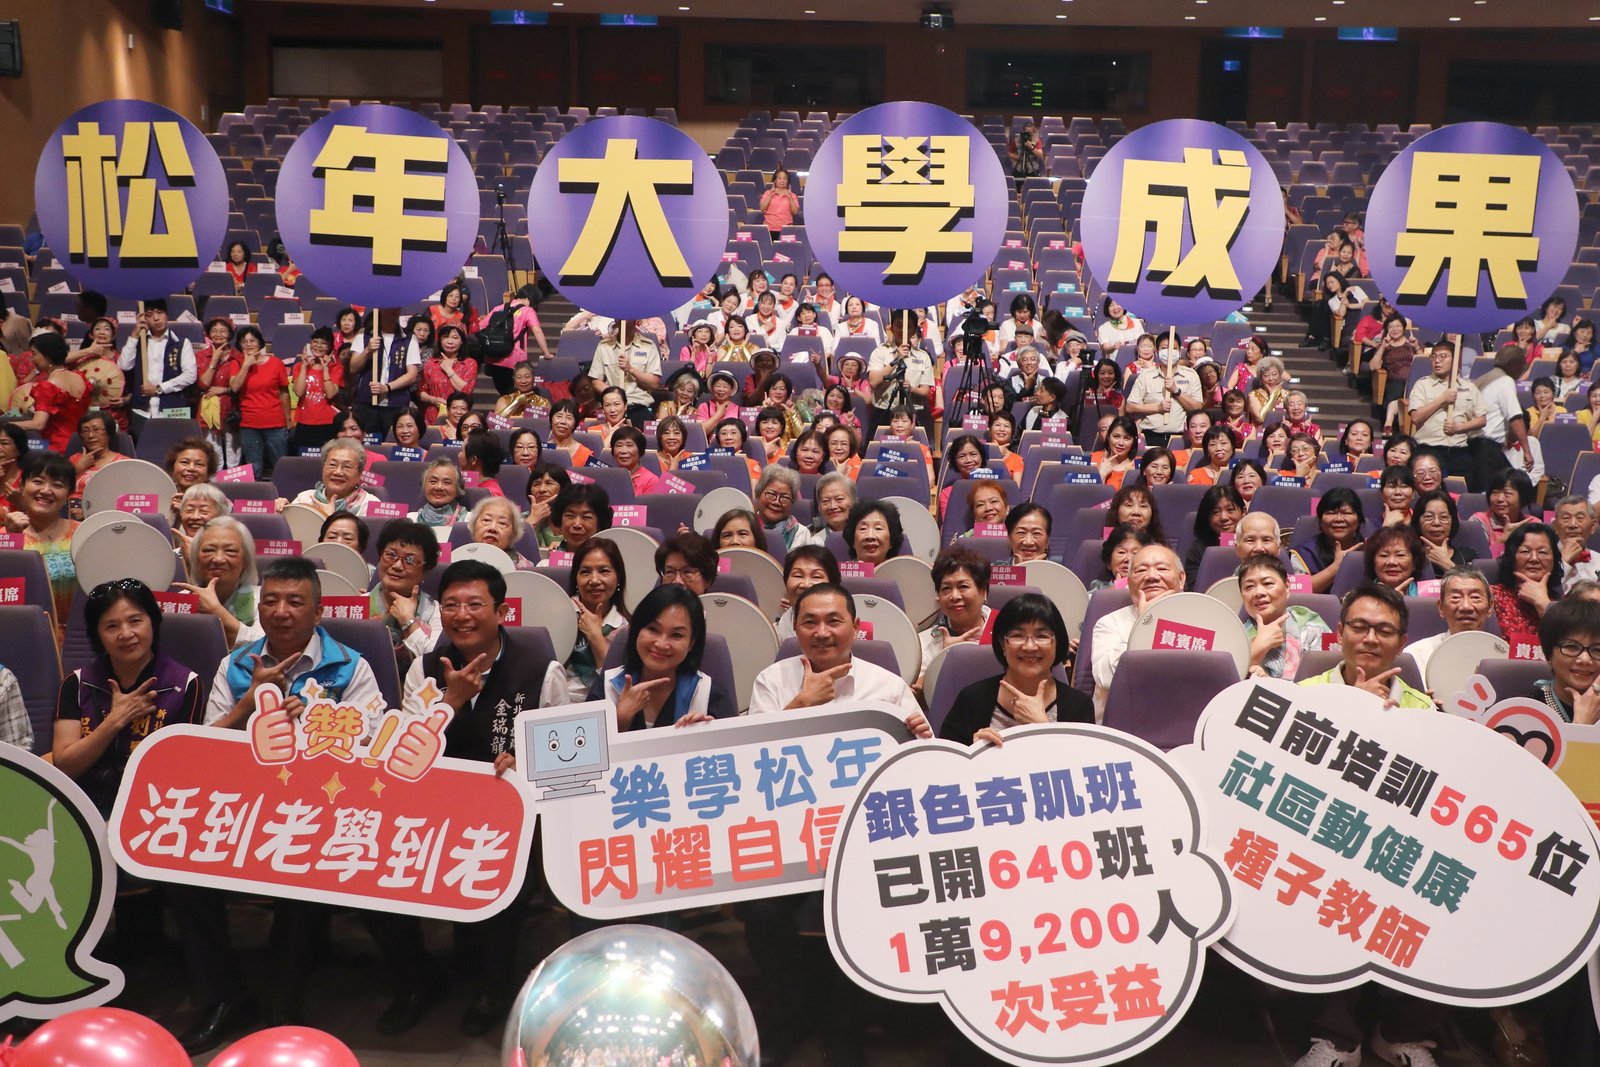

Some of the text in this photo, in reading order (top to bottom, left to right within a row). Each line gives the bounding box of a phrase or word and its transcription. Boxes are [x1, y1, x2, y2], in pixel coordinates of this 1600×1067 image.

[62, 121, 198, 262] 松
[311, 125, 449, 271] 年
[558, 138, 693, 282] 大
[836, 134, 975, 278] 學
[1107, 148, 1251, 293] 成
[1396, 151, 1542, 302] 果
[0, 587, 18, 602] 席
[1160, 630, 1207, 651] 貴賓席
[491, 698, 512, 755] 金瑞龍
[610, 736, 882, 830] 樂學松年
[1234, 684, 1590, 896] 目前培訓565位
[130, 783, 510, 899] 活到老學到老
[579, 804, 845, 905] 閃耀自信
[863, 761, 1142, 842] 銀色奇肌班
[1218, 749, 1477, 914] 社區動健康
[889, 889, 1199, 975] 1萬9,200人
[1223, 828, 1431, 968] 種子教師
[990, 963, 1167, 1037] 次受益
